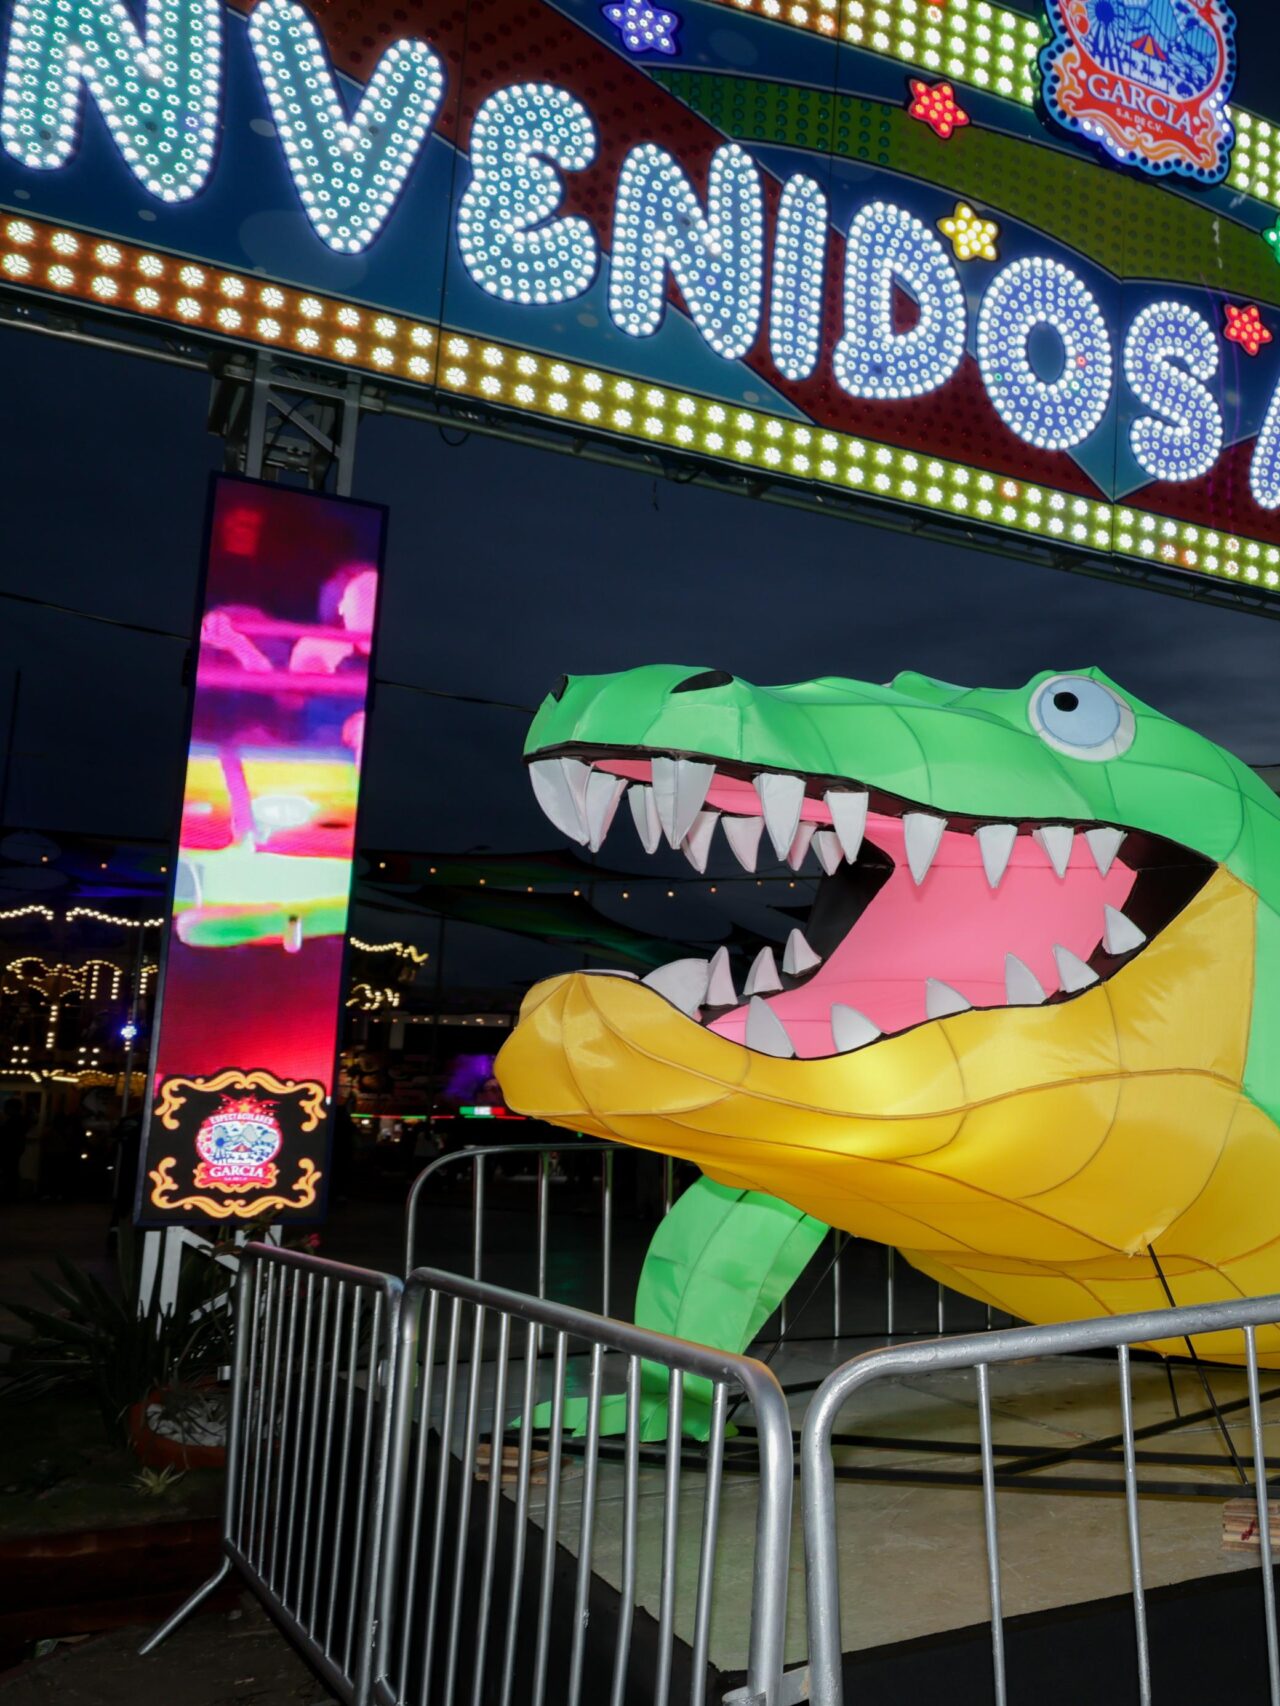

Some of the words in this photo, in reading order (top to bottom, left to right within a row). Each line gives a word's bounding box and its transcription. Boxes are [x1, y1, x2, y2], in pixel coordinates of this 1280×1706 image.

[1086, 73, 1194, 137] GARCIA
[1115, 107, 1133, 121] S.A.
[1134, 114, 1146, 127] DE
[1147, 118, 1164, 134] C.V.
[208, 1165, 265, 1178] GARCIA
